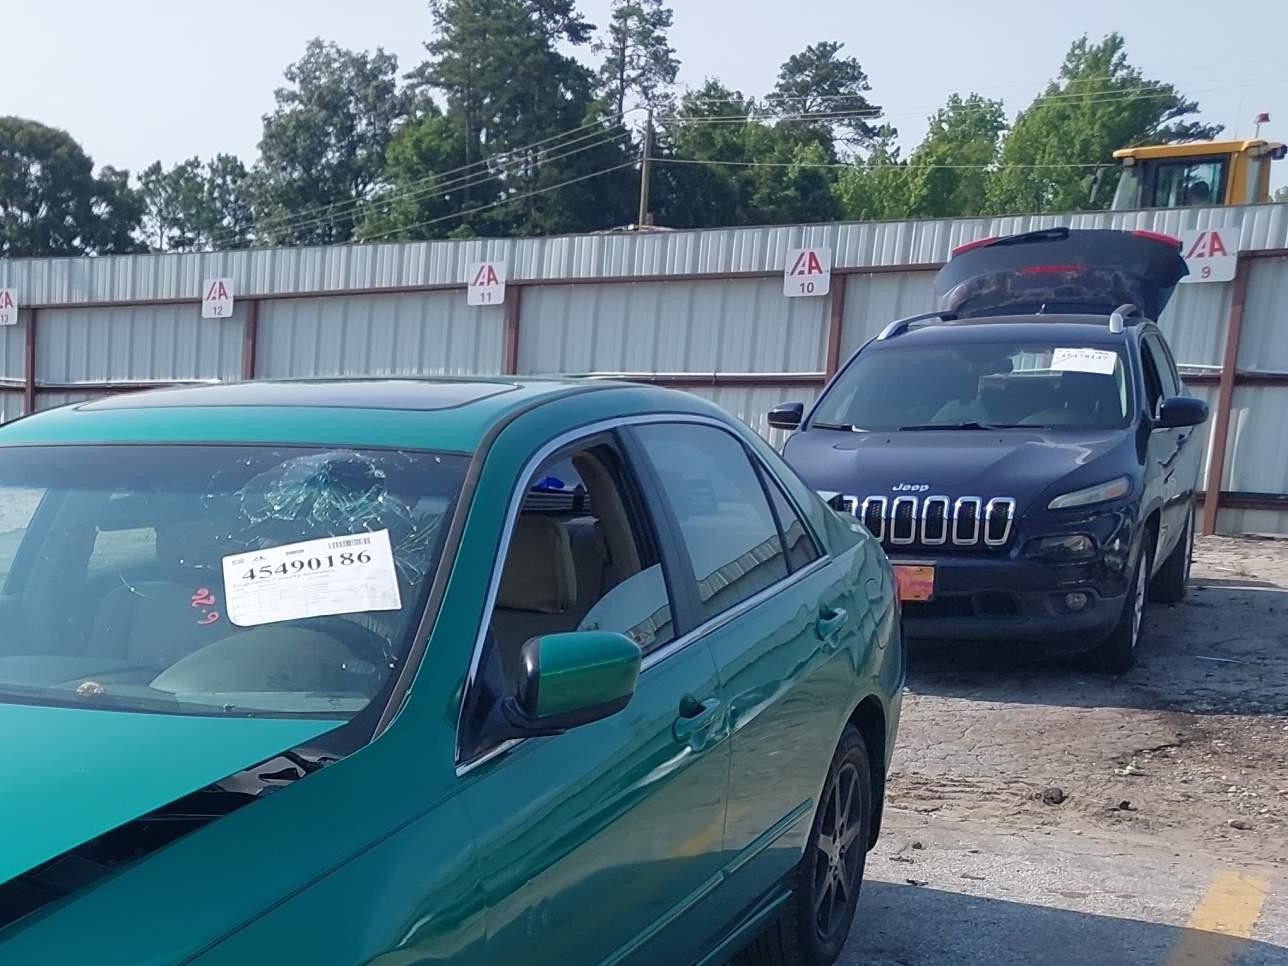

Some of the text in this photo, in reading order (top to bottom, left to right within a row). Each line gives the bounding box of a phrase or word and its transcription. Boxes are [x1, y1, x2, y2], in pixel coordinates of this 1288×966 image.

[1201, 265, 1211, 279] 9
[799, 282, 815, 294] 10
[480, 292, 492, 303] 11
[212, 305, 224, 316] 12
[892, 482, 930, 493] Jeep
[241, 549, 372, 581] 45490186
